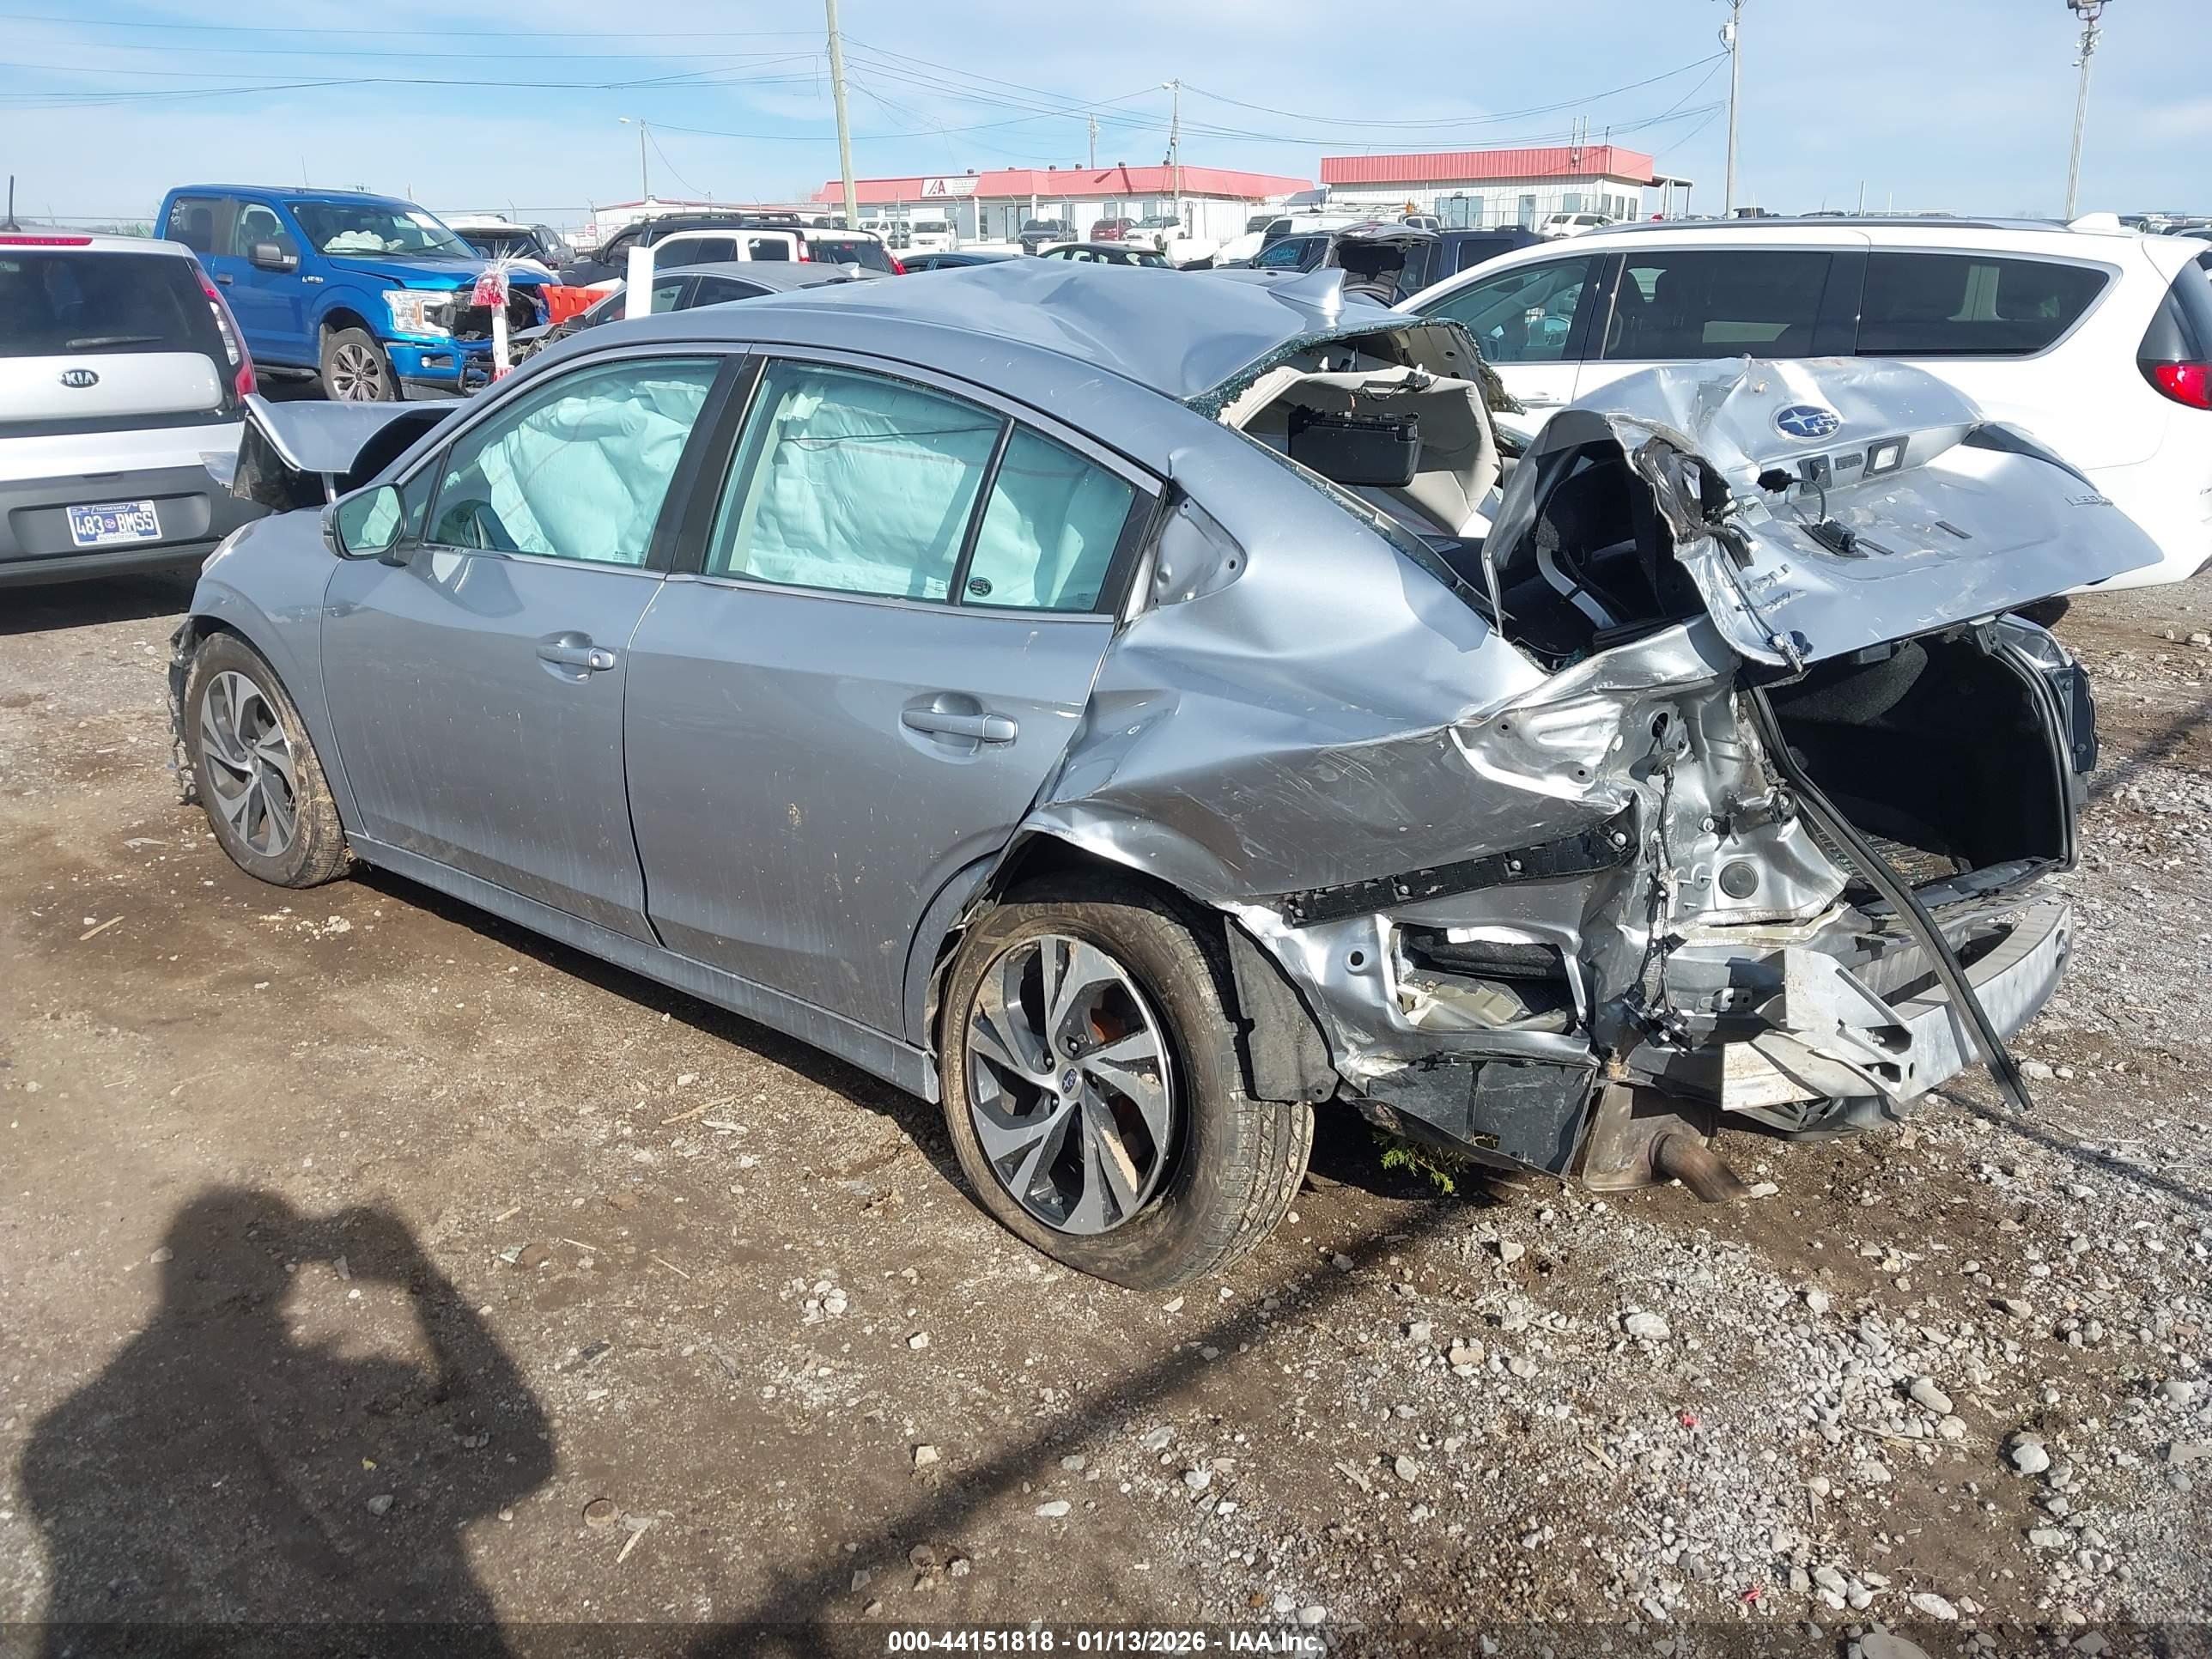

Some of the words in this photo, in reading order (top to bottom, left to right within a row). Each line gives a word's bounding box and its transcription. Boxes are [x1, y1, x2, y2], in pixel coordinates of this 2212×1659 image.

[64, 371, 96, 386] KIA
[76, 515, 105, 536] 483
[115, 511, 155, 533] BMSS
